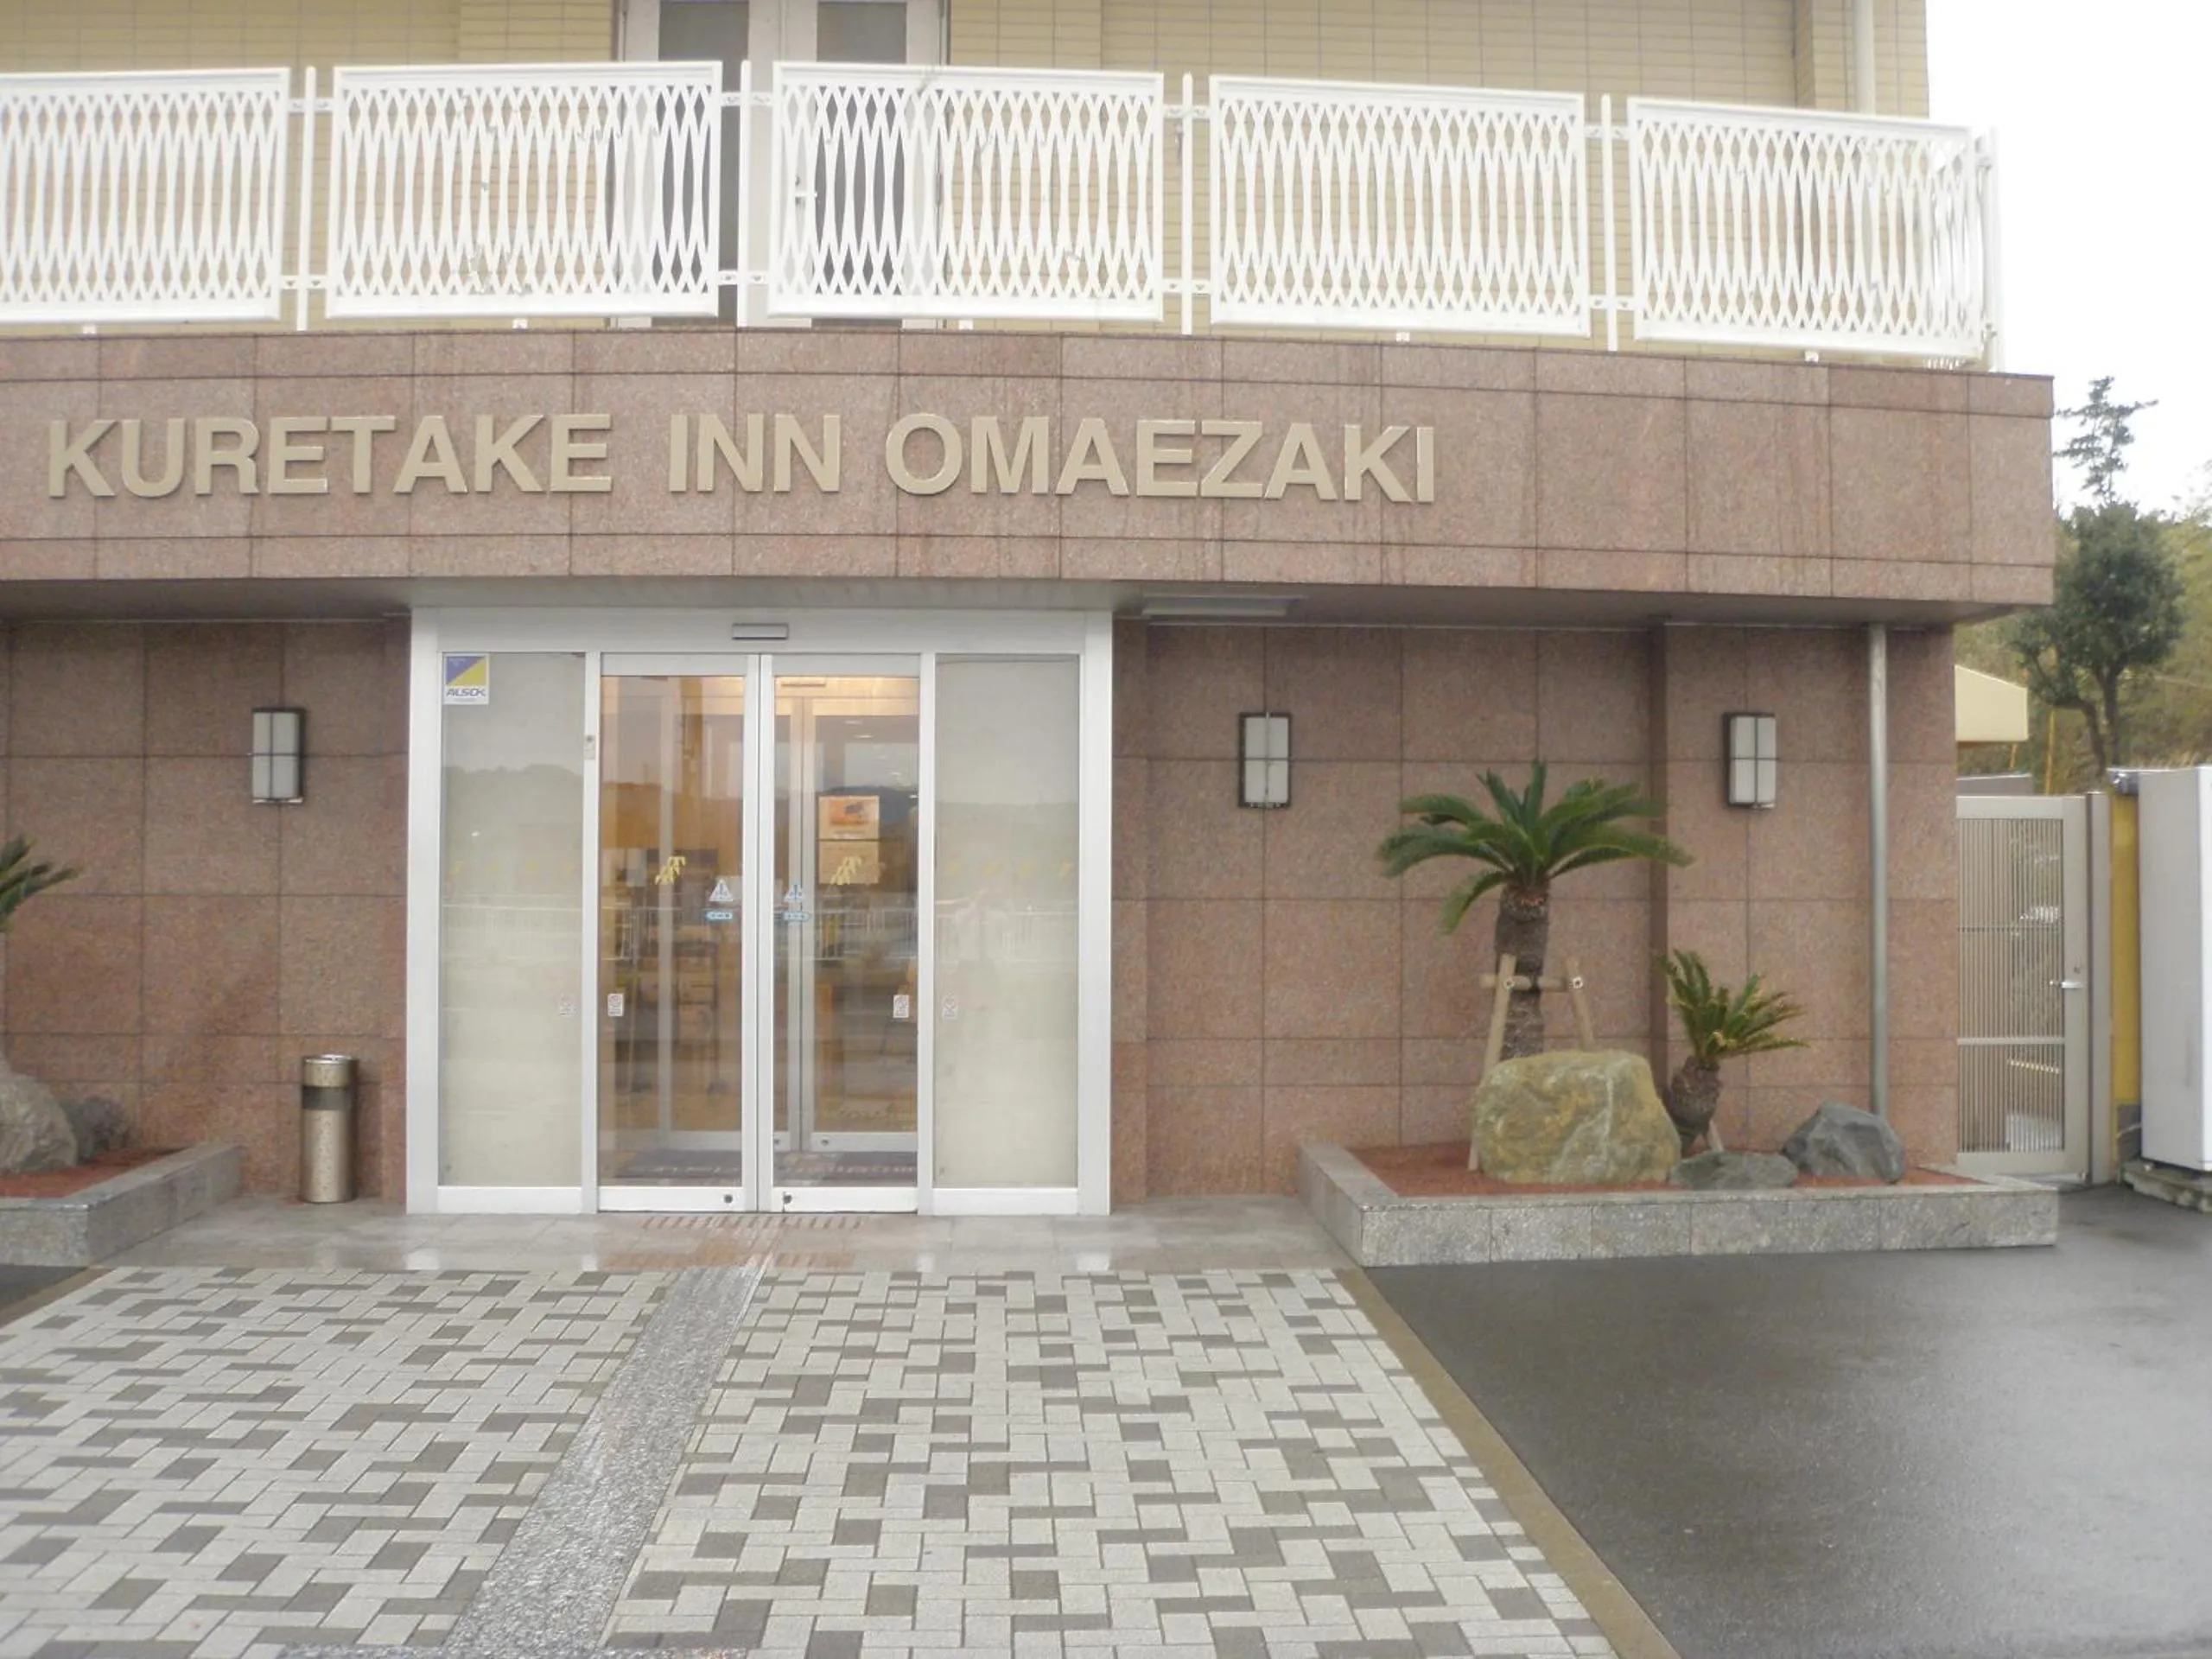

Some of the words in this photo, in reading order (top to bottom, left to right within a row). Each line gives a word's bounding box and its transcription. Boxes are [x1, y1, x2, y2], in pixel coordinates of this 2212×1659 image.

[48, 414, 612, 498] KURETAKE
[669, 413, 841, 493] INN
[885, 412, 1434, 502] OMAEZAKI
[446, 688, 486, 697] ALSOK
